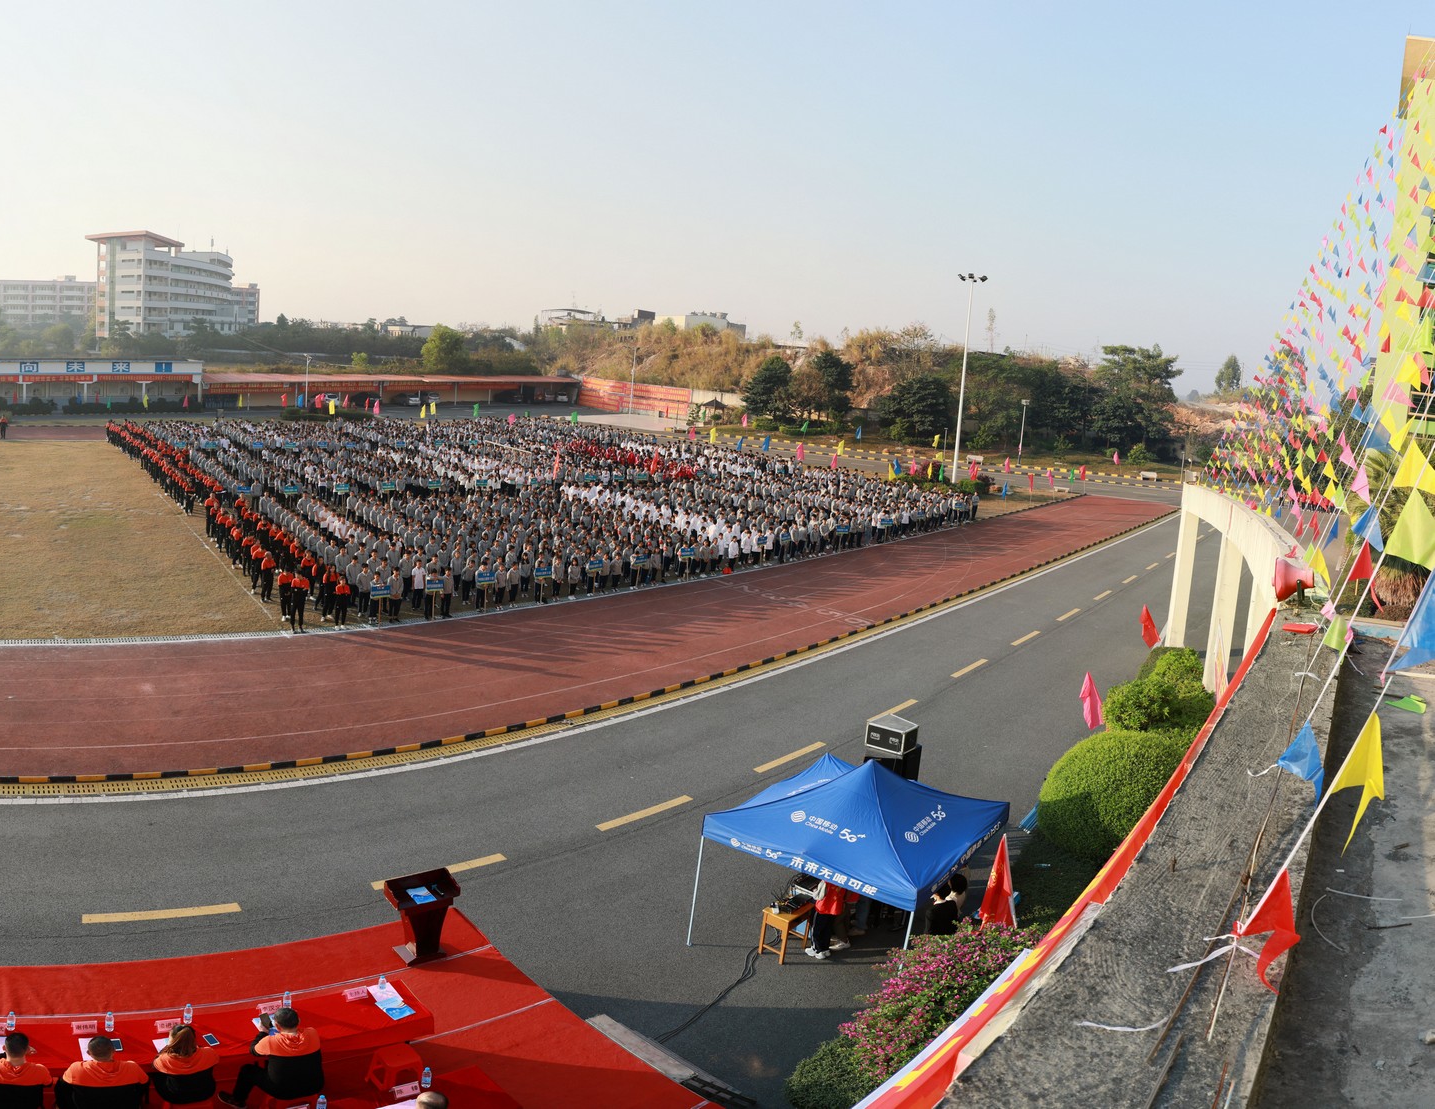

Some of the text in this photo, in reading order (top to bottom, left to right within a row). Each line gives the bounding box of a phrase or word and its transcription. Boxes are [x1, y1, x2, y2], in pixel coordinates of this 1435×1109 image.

[805, 821, 834, 835] China Mobile
[808, 815, 838, 831] 中国移动
[790, 856, 878, 896] 未来无限可能
